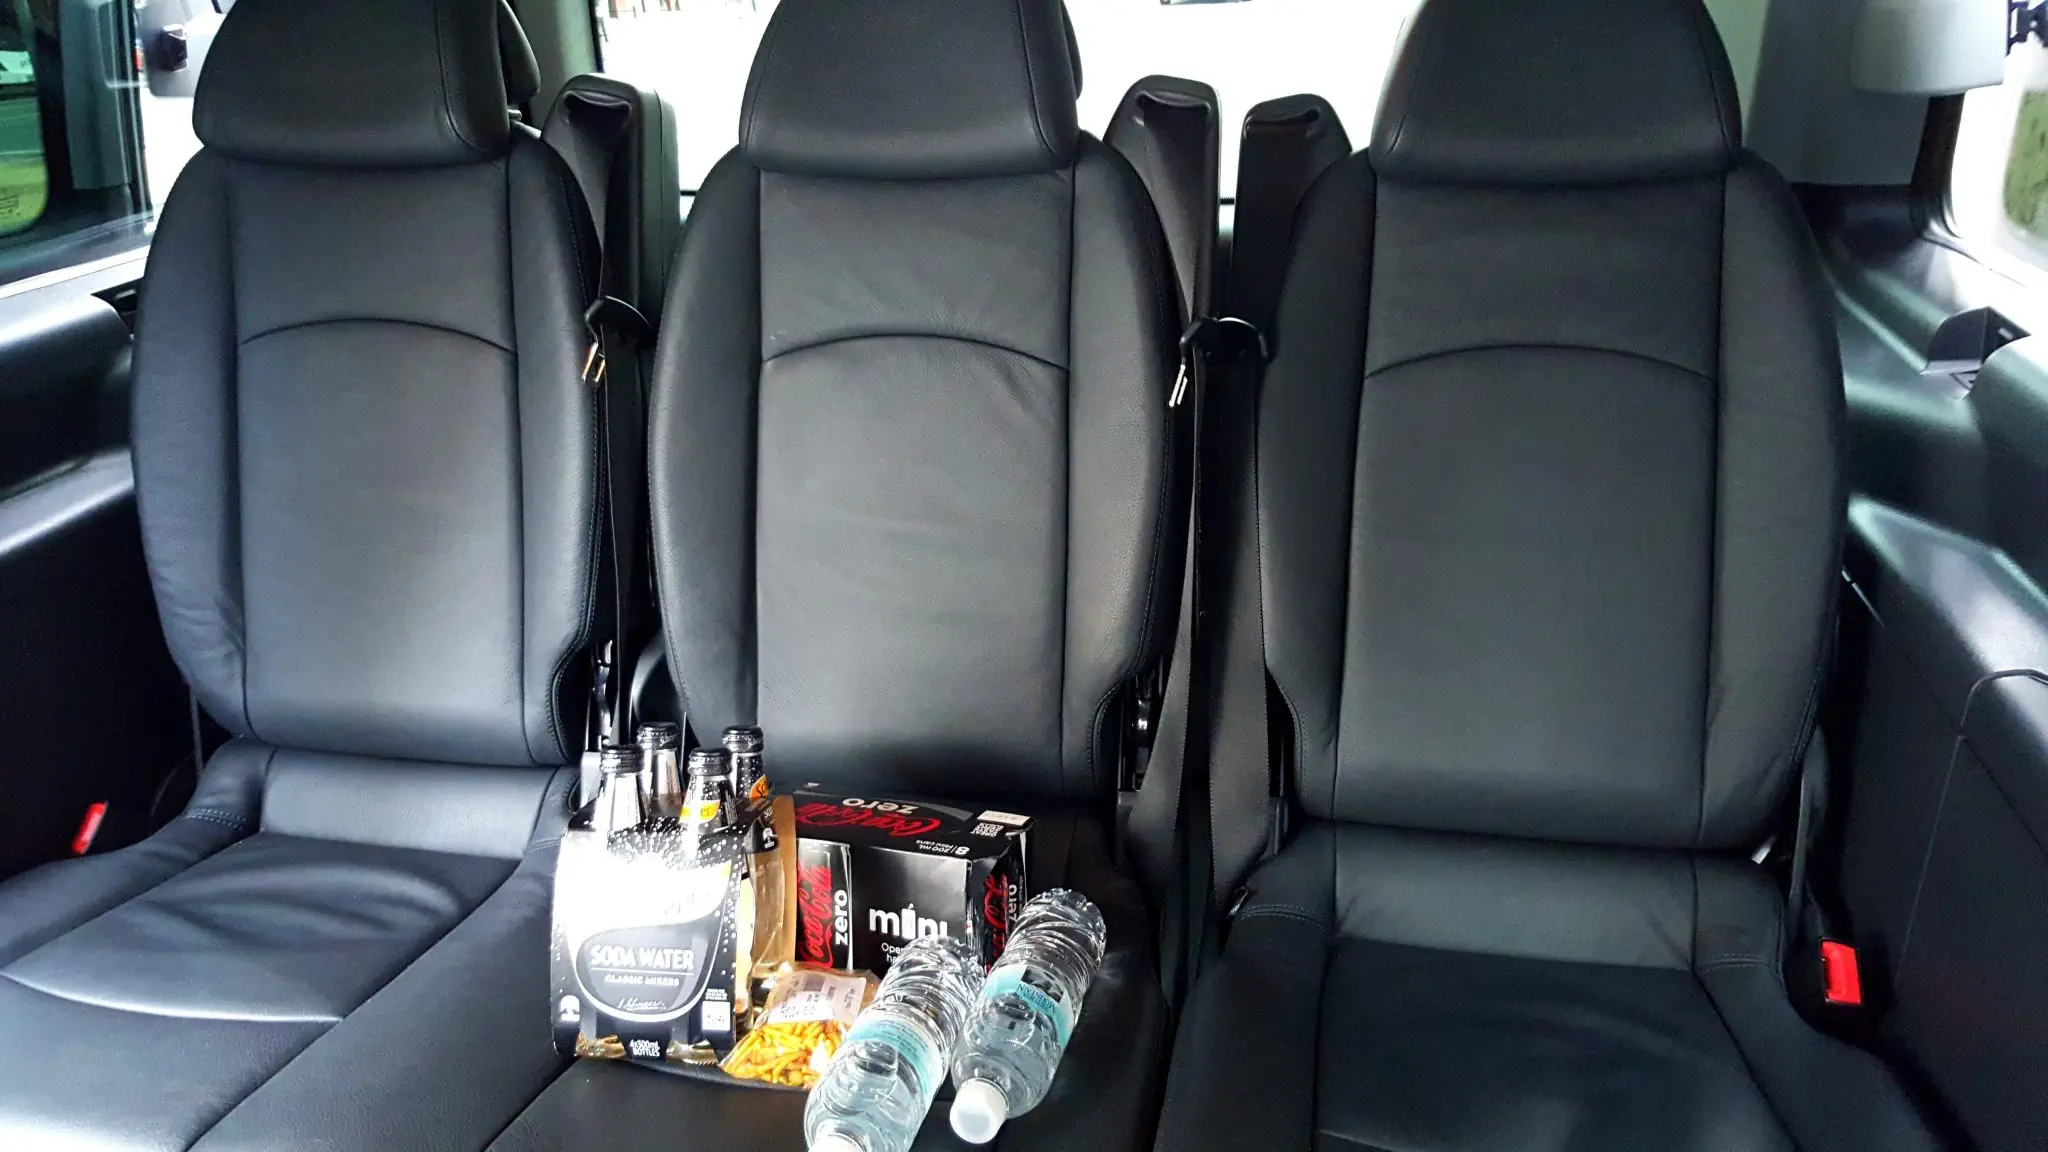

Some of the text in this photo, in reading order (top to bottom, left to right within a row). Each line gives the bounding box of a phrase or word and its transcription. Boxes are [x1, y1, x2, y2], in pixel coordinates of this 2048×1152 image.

[842, 797, 920, 816] zero
[955, 846, 970, 855] 8
[834, 889, 848, 946] zero
[590, 944, 694, 970] SODA WATER
[632, 1047, 660, 1057] BOTTLES
